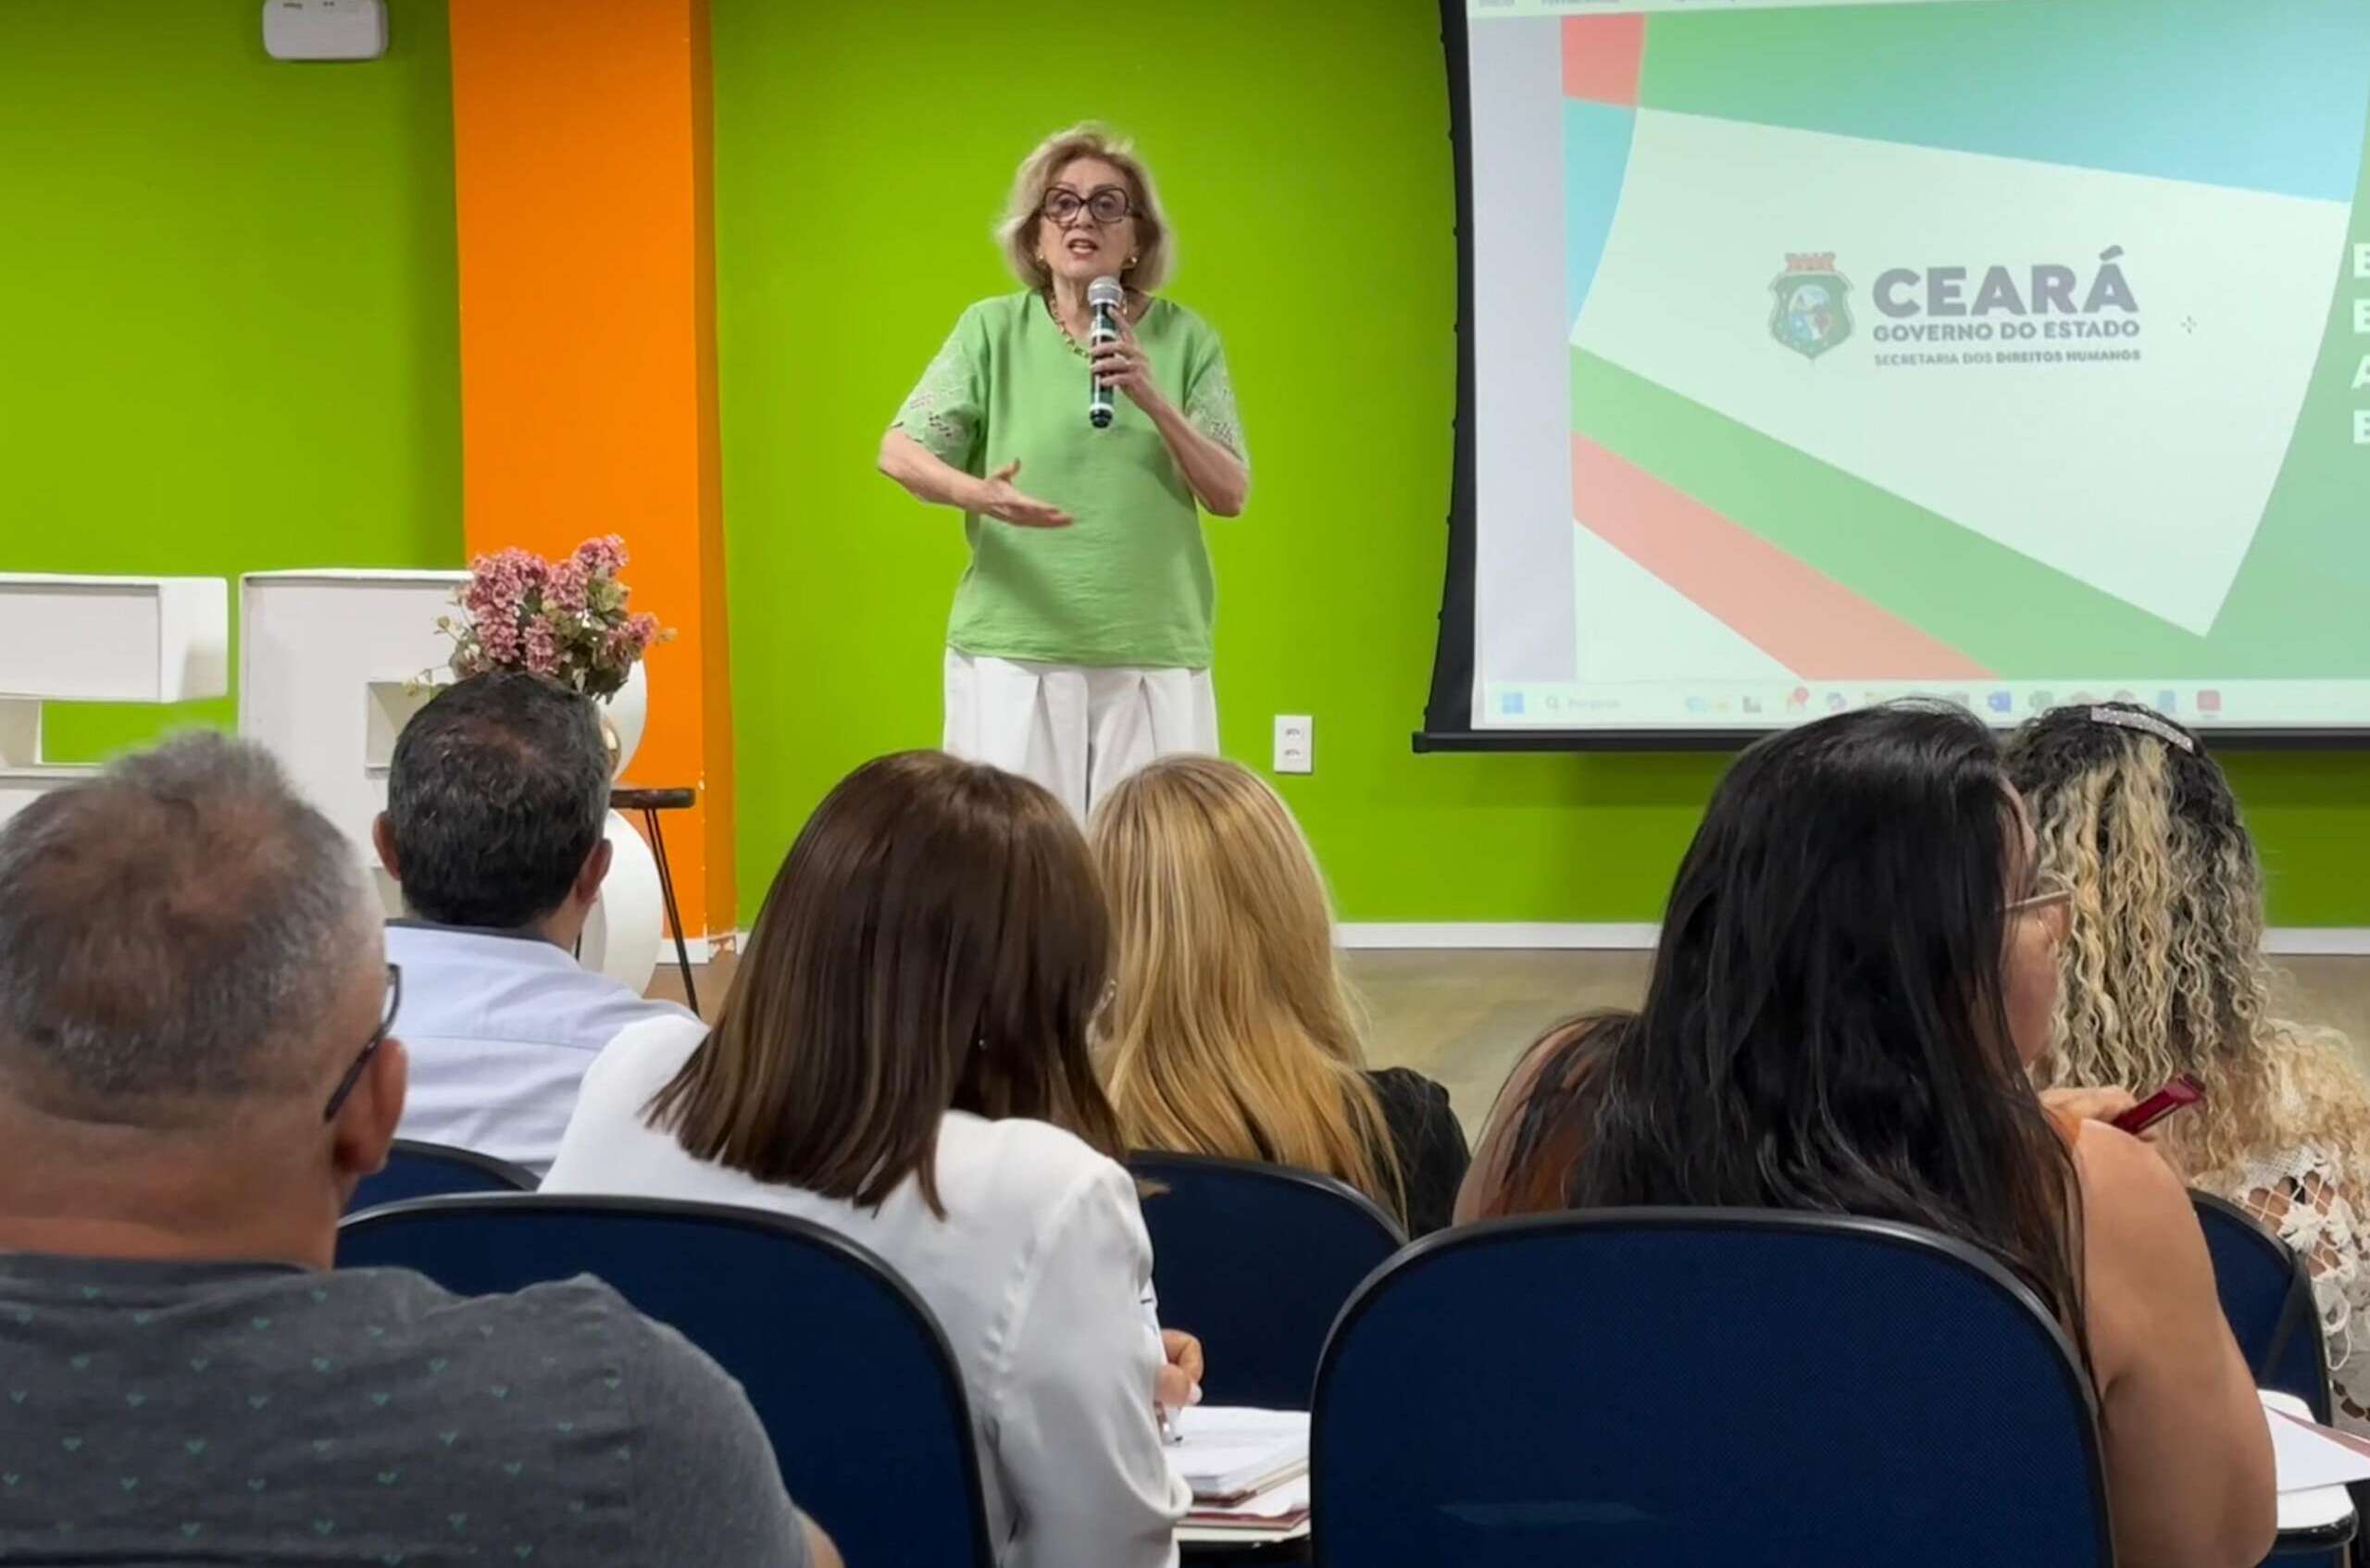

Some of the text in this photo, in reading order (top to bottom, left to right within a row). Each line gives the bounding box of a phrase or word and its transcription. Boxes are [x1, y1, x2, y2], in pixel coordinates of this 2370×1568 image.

[1872, 244, 2139, 317] CEARÁ
[1873, 319, 2140, 342] GOVERNO DO ESTADO
[1874, 348, 2141, 367] SECRETARIA DOS DIREITOS HUMANOS
